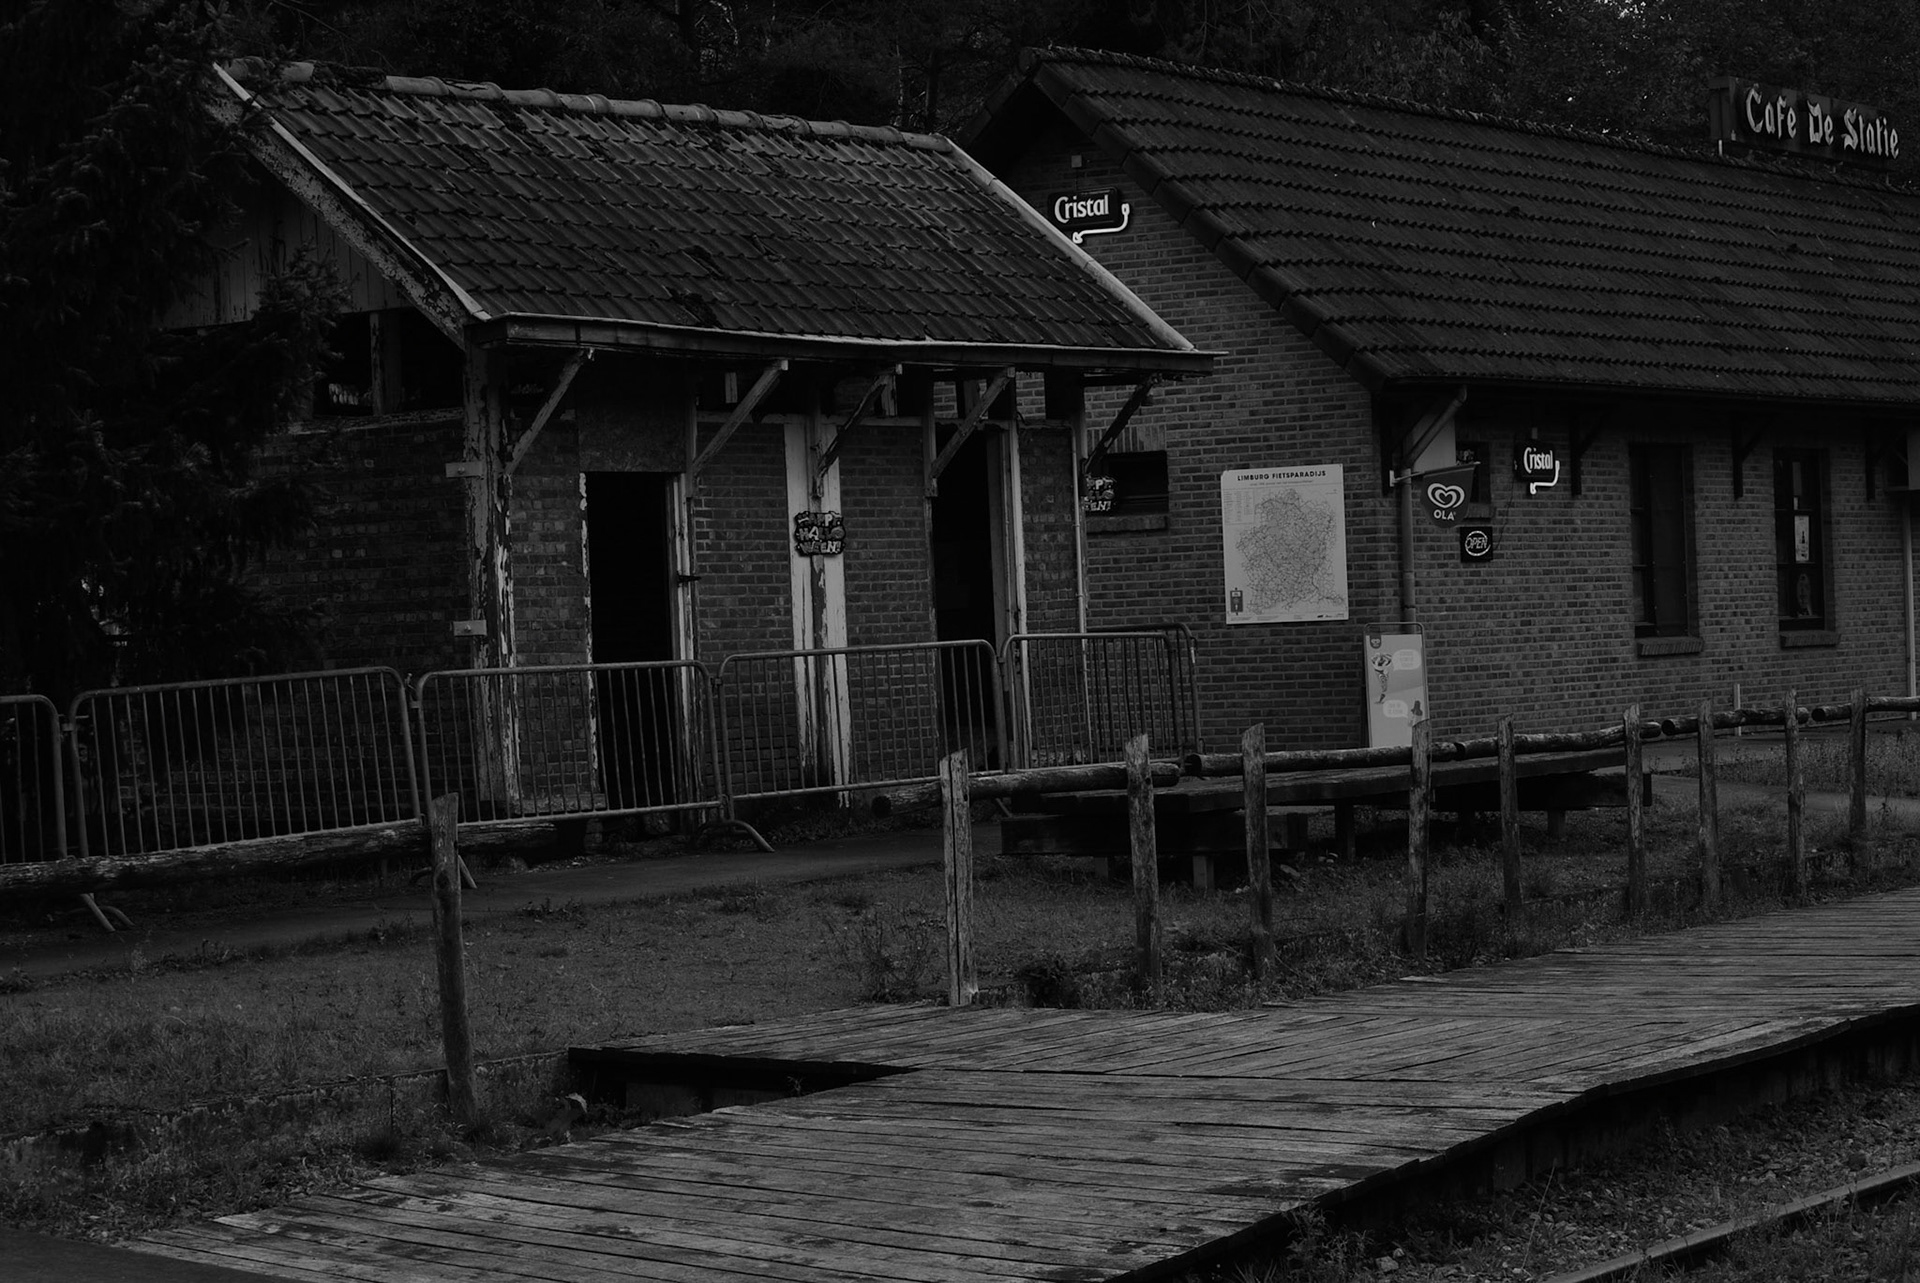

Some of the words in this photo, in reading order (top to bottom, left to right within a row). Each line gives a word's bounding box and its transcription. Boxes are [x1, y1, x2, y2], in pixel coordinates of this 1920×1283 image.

[1745, 83, 1797, 140] Cafe
[1806, 100, 1834, 146] De
[1841, 107, 1900, 160] Statie
[1054, 194, 1109, 224] Cristal
[1523, 446, 1553, 474] Cristal
[1237, 473, 1270, 481] LIMBURG
[1272, 470, 1326, 479] FIETSPARADIJS
[1433, 508, 1455, 521] OLA
[1465, 536, 1488, 550] OPEN
